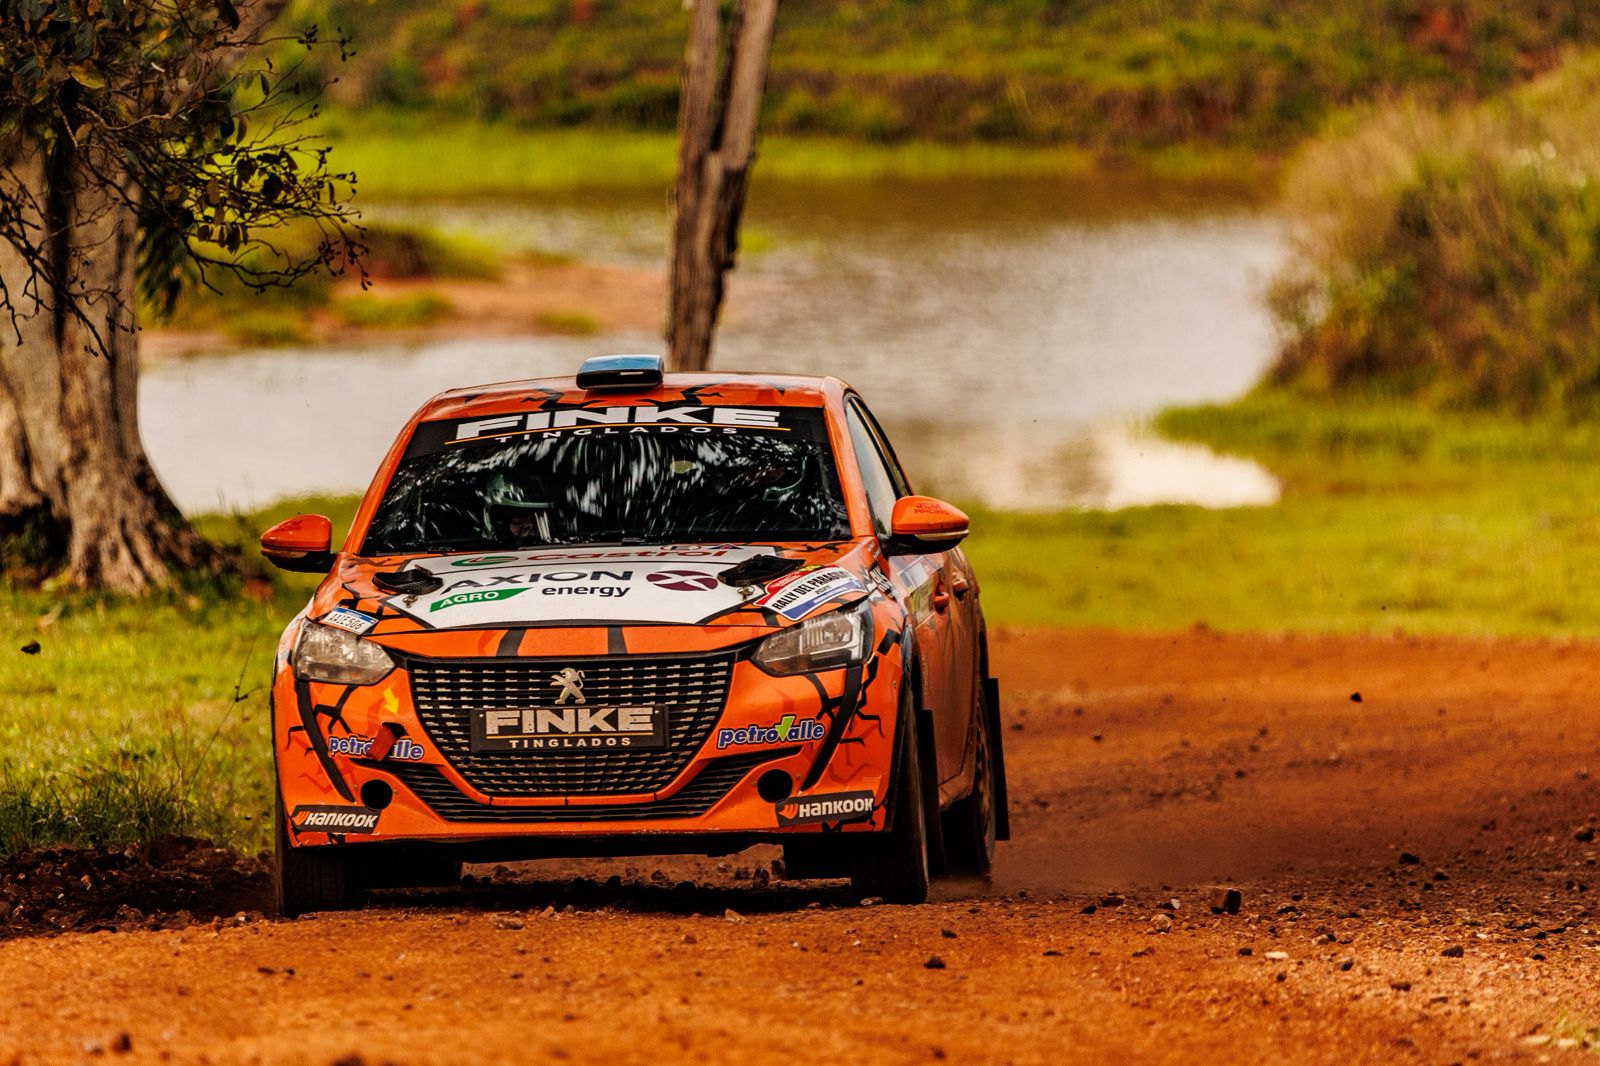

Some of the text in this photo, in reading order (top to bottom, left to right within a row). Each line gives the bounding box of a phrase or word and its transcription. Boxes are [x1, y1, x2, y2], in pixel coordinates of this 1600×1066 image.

[456, 406, 780, 440] FINKE
[495, 427, 738, 443] TINGLADOS
[527, 550, 728, 561] Castrol
[441, 570, 634, 595] AXION
[439, 591, 499, 607] AGRO
[541, 585, 631, 598] energy
[771, 590, 800, 611] RALLY
[793, 581, 815, 596] DEL
[485, 707, 653, 735] FINKE
[509, 737, 632, 749] TINGLADOS
